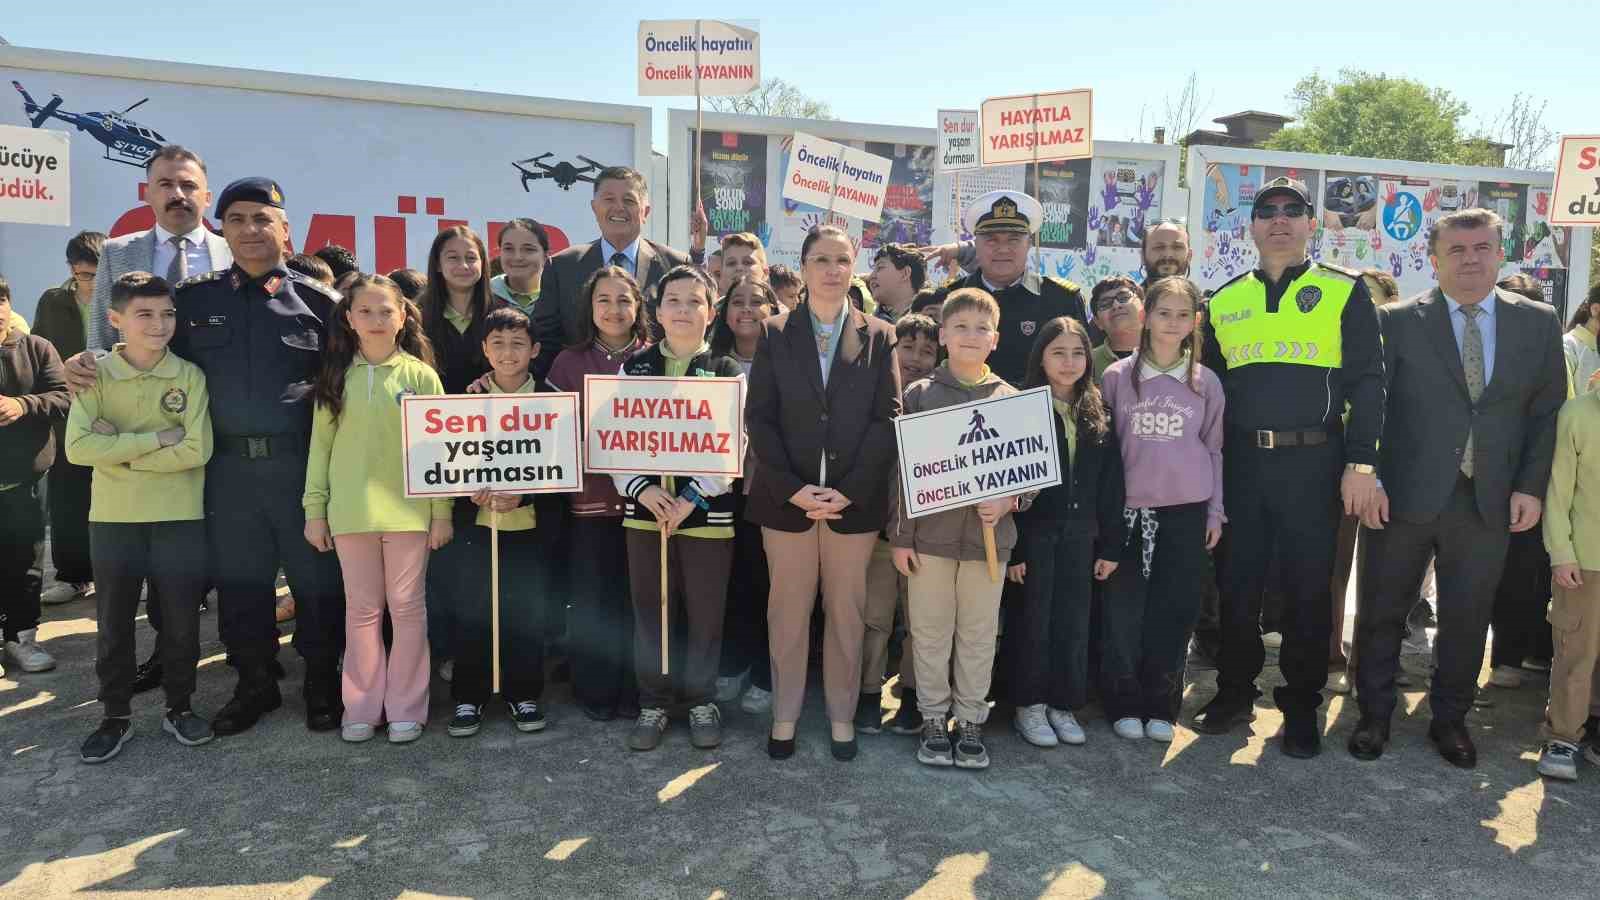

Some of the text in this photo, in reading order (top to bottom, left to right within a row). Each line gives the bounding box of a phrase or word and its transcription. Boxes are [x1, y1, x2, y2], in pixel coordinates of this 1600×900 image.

[645, 32, 753, 55] Öncelik hayatın
[645, 62, 753, 80] Öncelik YAYANIN
[943, 118, 975, 133] Sen dur
[1000, 106, 1071, 127] HAYATLA
[948, 136, 971, 151] yaşam
[990, 128, 1084, 151] YARIŞILMAZ
[798, 144, 883, 184] Öncelik hayatın
[943, 151, 975, 165] durmasın
[1577, 146, 1600, 170] S
[792, 170, 831, 194] Öncelik
[833, 184, 879, 208] YAYANIN
[716, 199, 743, 210] SONU
[424, 406, 559, 433] Sen dur
[612, 398, 712, 420] HAYATLA
[1132, 413, 1183, 437] 1992
[445, 437, 542, 462] yaşam
[597, 430, 730, 458] YARIŞILMAZ
[913, 434, 1049, 479] ÖNCELİK HAYATIN,
[424, 462, 563, 485] durmasın
[916, 460, 1049, 506] ÖNCELİK YAYANIN
